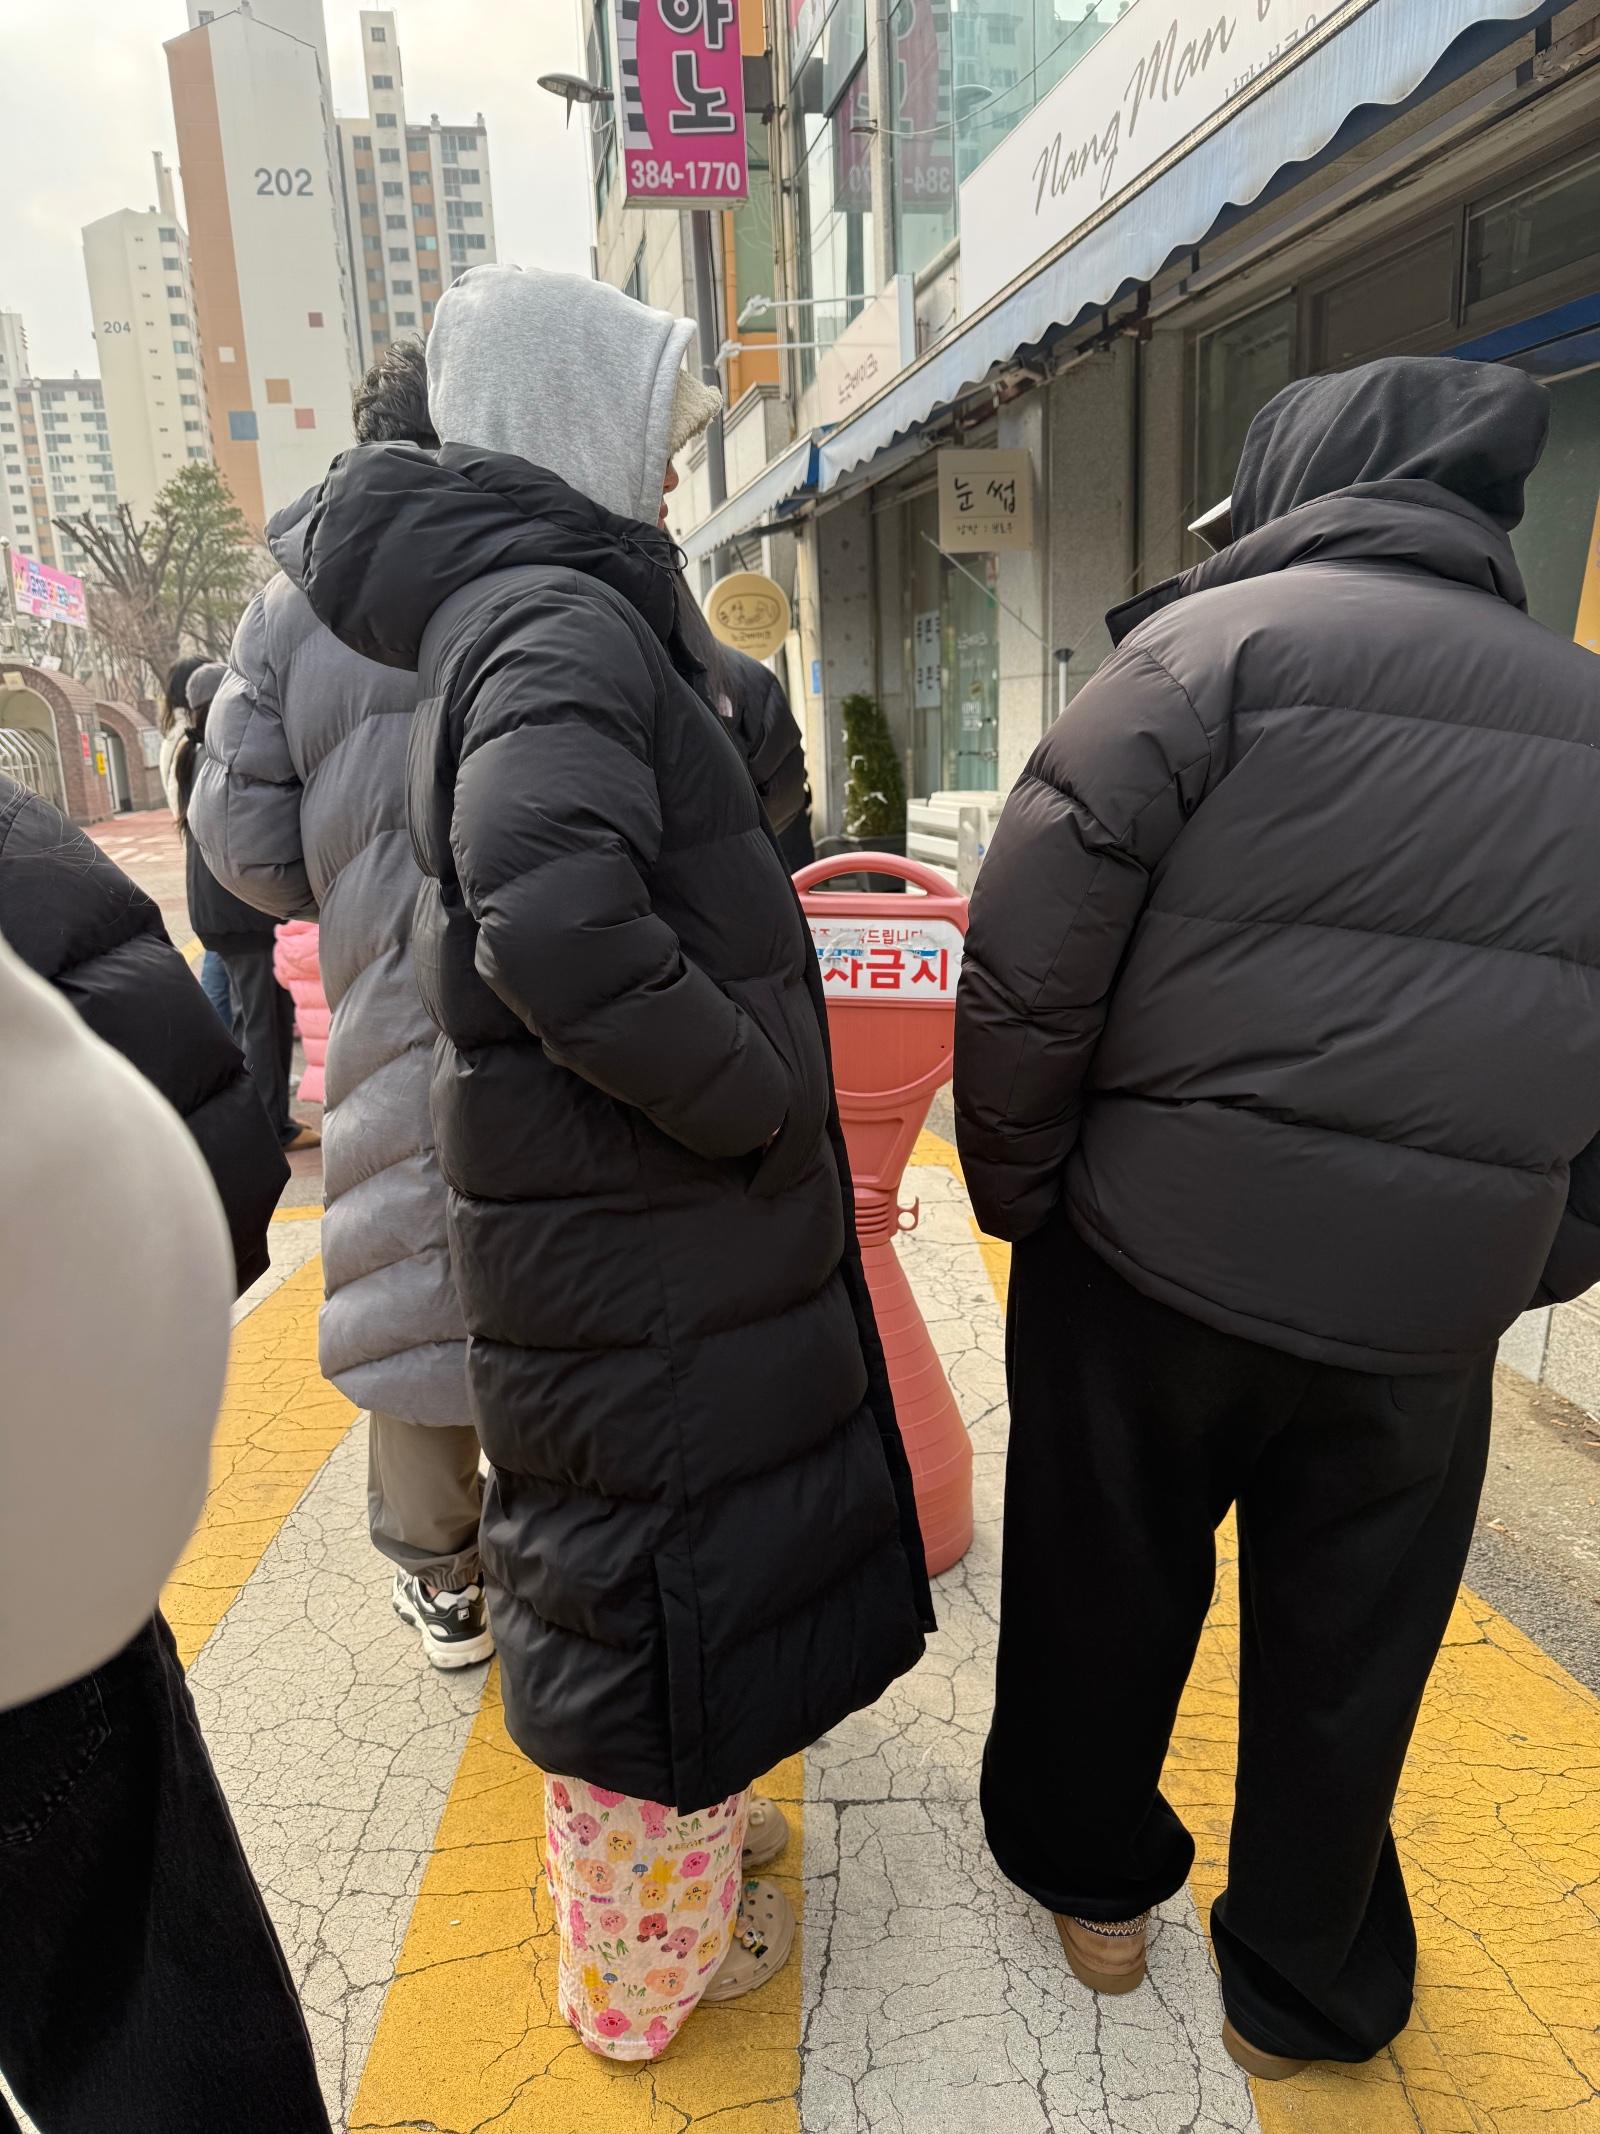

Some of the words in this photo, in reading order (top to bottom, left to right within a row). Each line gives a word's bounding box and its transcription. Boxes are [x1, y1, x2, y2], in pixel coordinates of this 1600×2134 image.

[1032, 110, 1121, 216] Nang
[1123, 15, 1237, 138] Man
[254, 167, 315, 197] 202
[630, 160, 741, 191] 384-1770
[103, 320, 132, 334] 204
